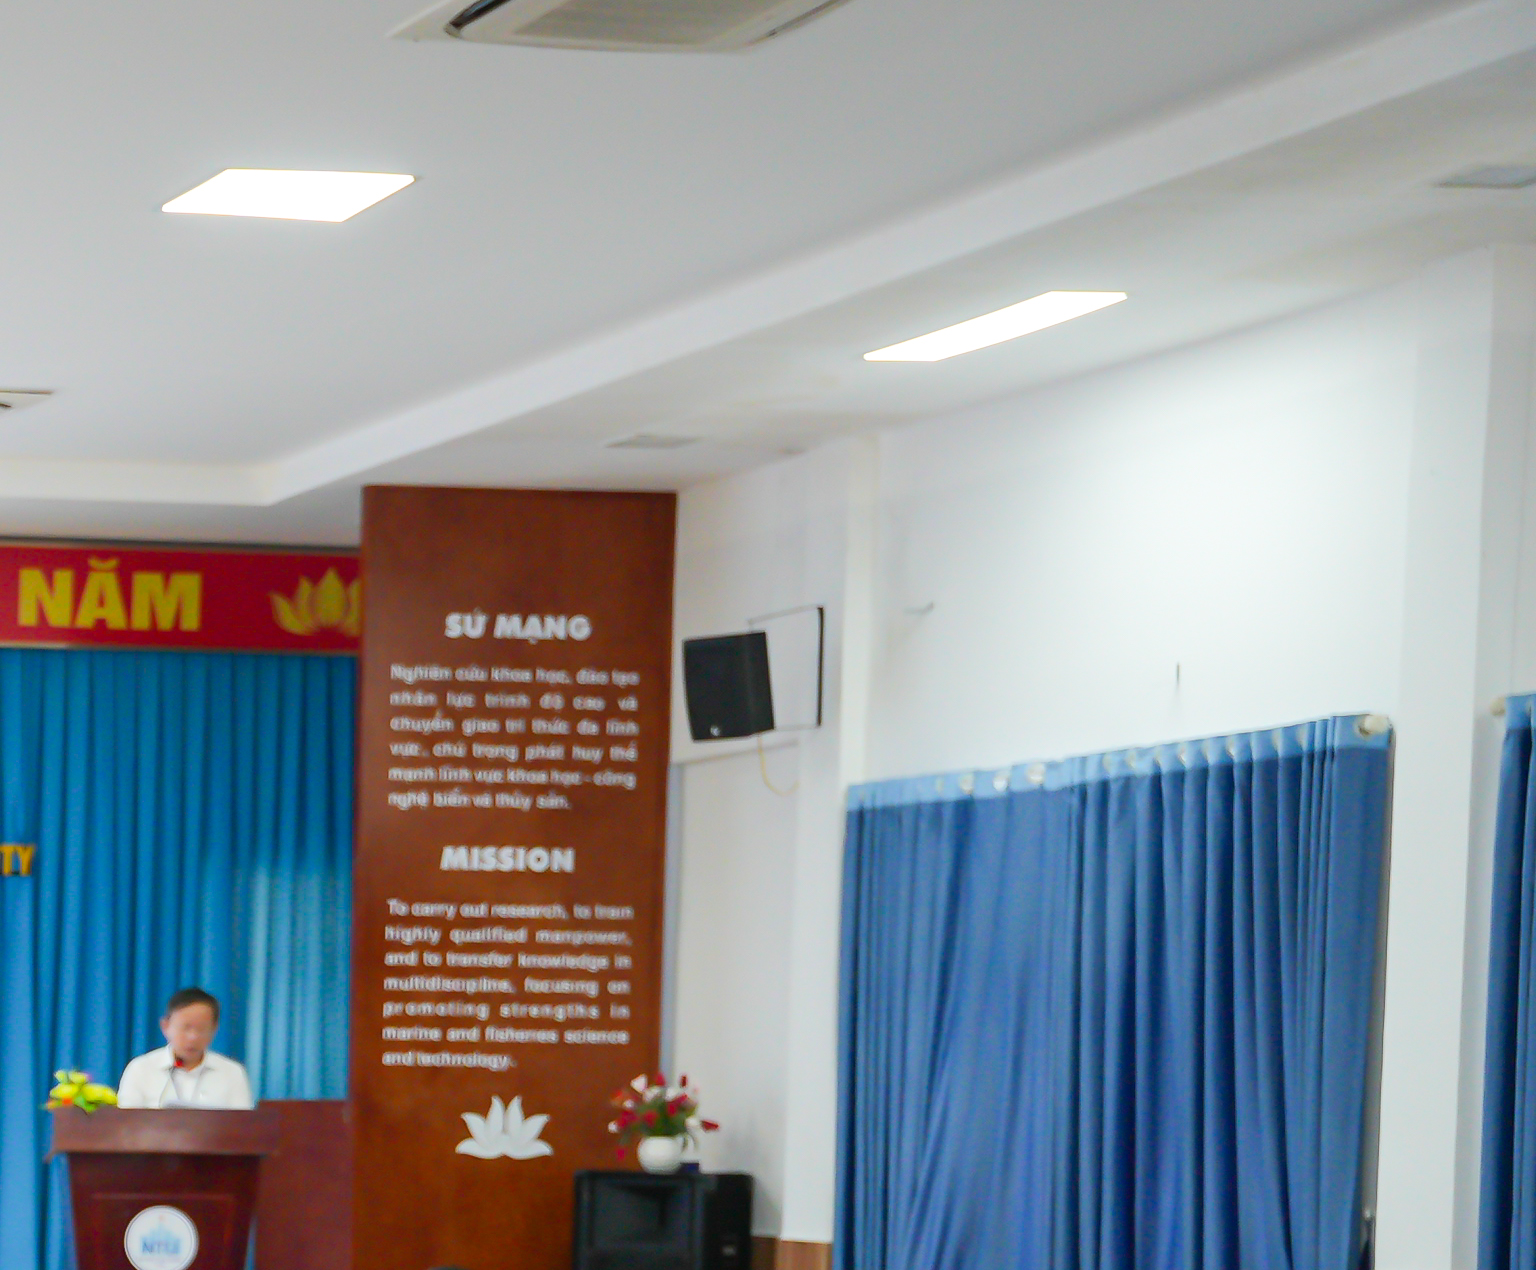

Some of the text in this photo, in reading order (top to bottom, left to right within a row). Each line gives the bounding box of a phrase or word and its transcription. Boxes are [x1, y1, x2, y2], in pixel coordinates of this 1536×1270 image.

[16, 556, 204, 633] NĂM
[444, 607, 593, 644] SỨ MẠNG
[440, 845, 576, 873] MISSION
[386, 898, 409, 916] To
[411, 902, 457, 920] carry
[460, 902, 489, 919] out
[573, 904, 592, 920] to
[594, 903, 635, 920] train
[384, 926, 441, 945] highly
[449, 926, 528, 944] qualified
[384, 950, 632, 972] and to transfer knowledge in
[524, 977, 599, 998] focusing
[607, 980, 630, 995] on
[382, 1002, 630, 1022] promoting strengths in
[382, 1026, 630, 1044] marine and fisheries science
[382, 1051, 414, 1067] and
